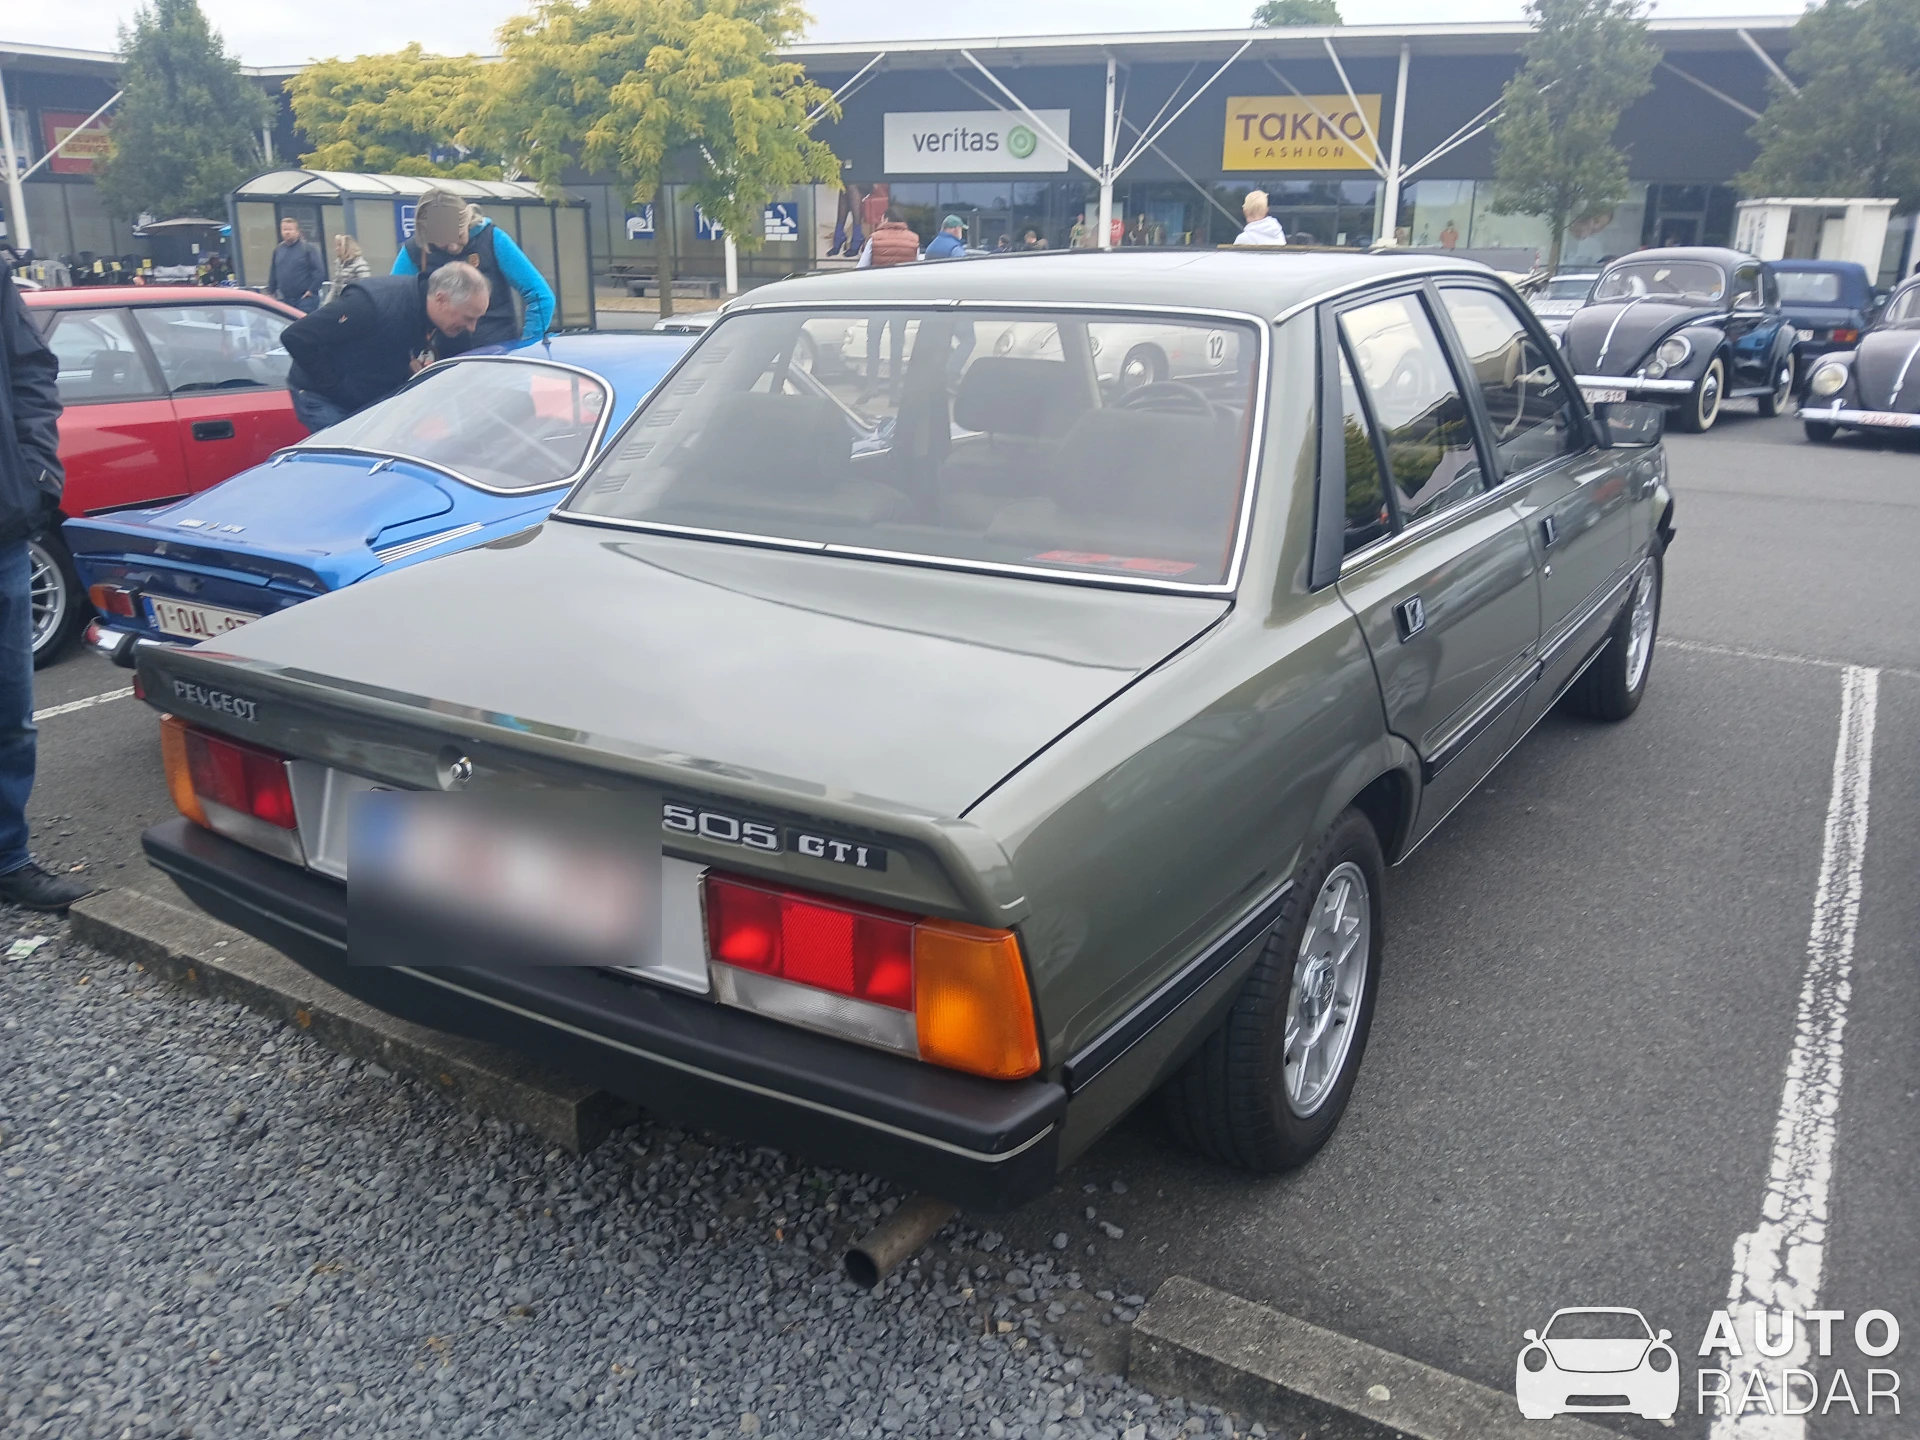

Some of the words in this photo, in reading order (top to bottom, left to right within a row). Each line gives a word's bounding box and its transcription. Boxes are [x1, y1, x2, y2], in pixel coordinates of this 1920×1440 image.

[912, 127, 1000, 152] veritas
[1253, 147, 1345, 158] FASHION
[1209, 335, 1224, 359] 12
[173, 680, 258, 722] PEUGEOT
[662, 803, 779, 851] 505
[798, 834, 868, 868] GTI
